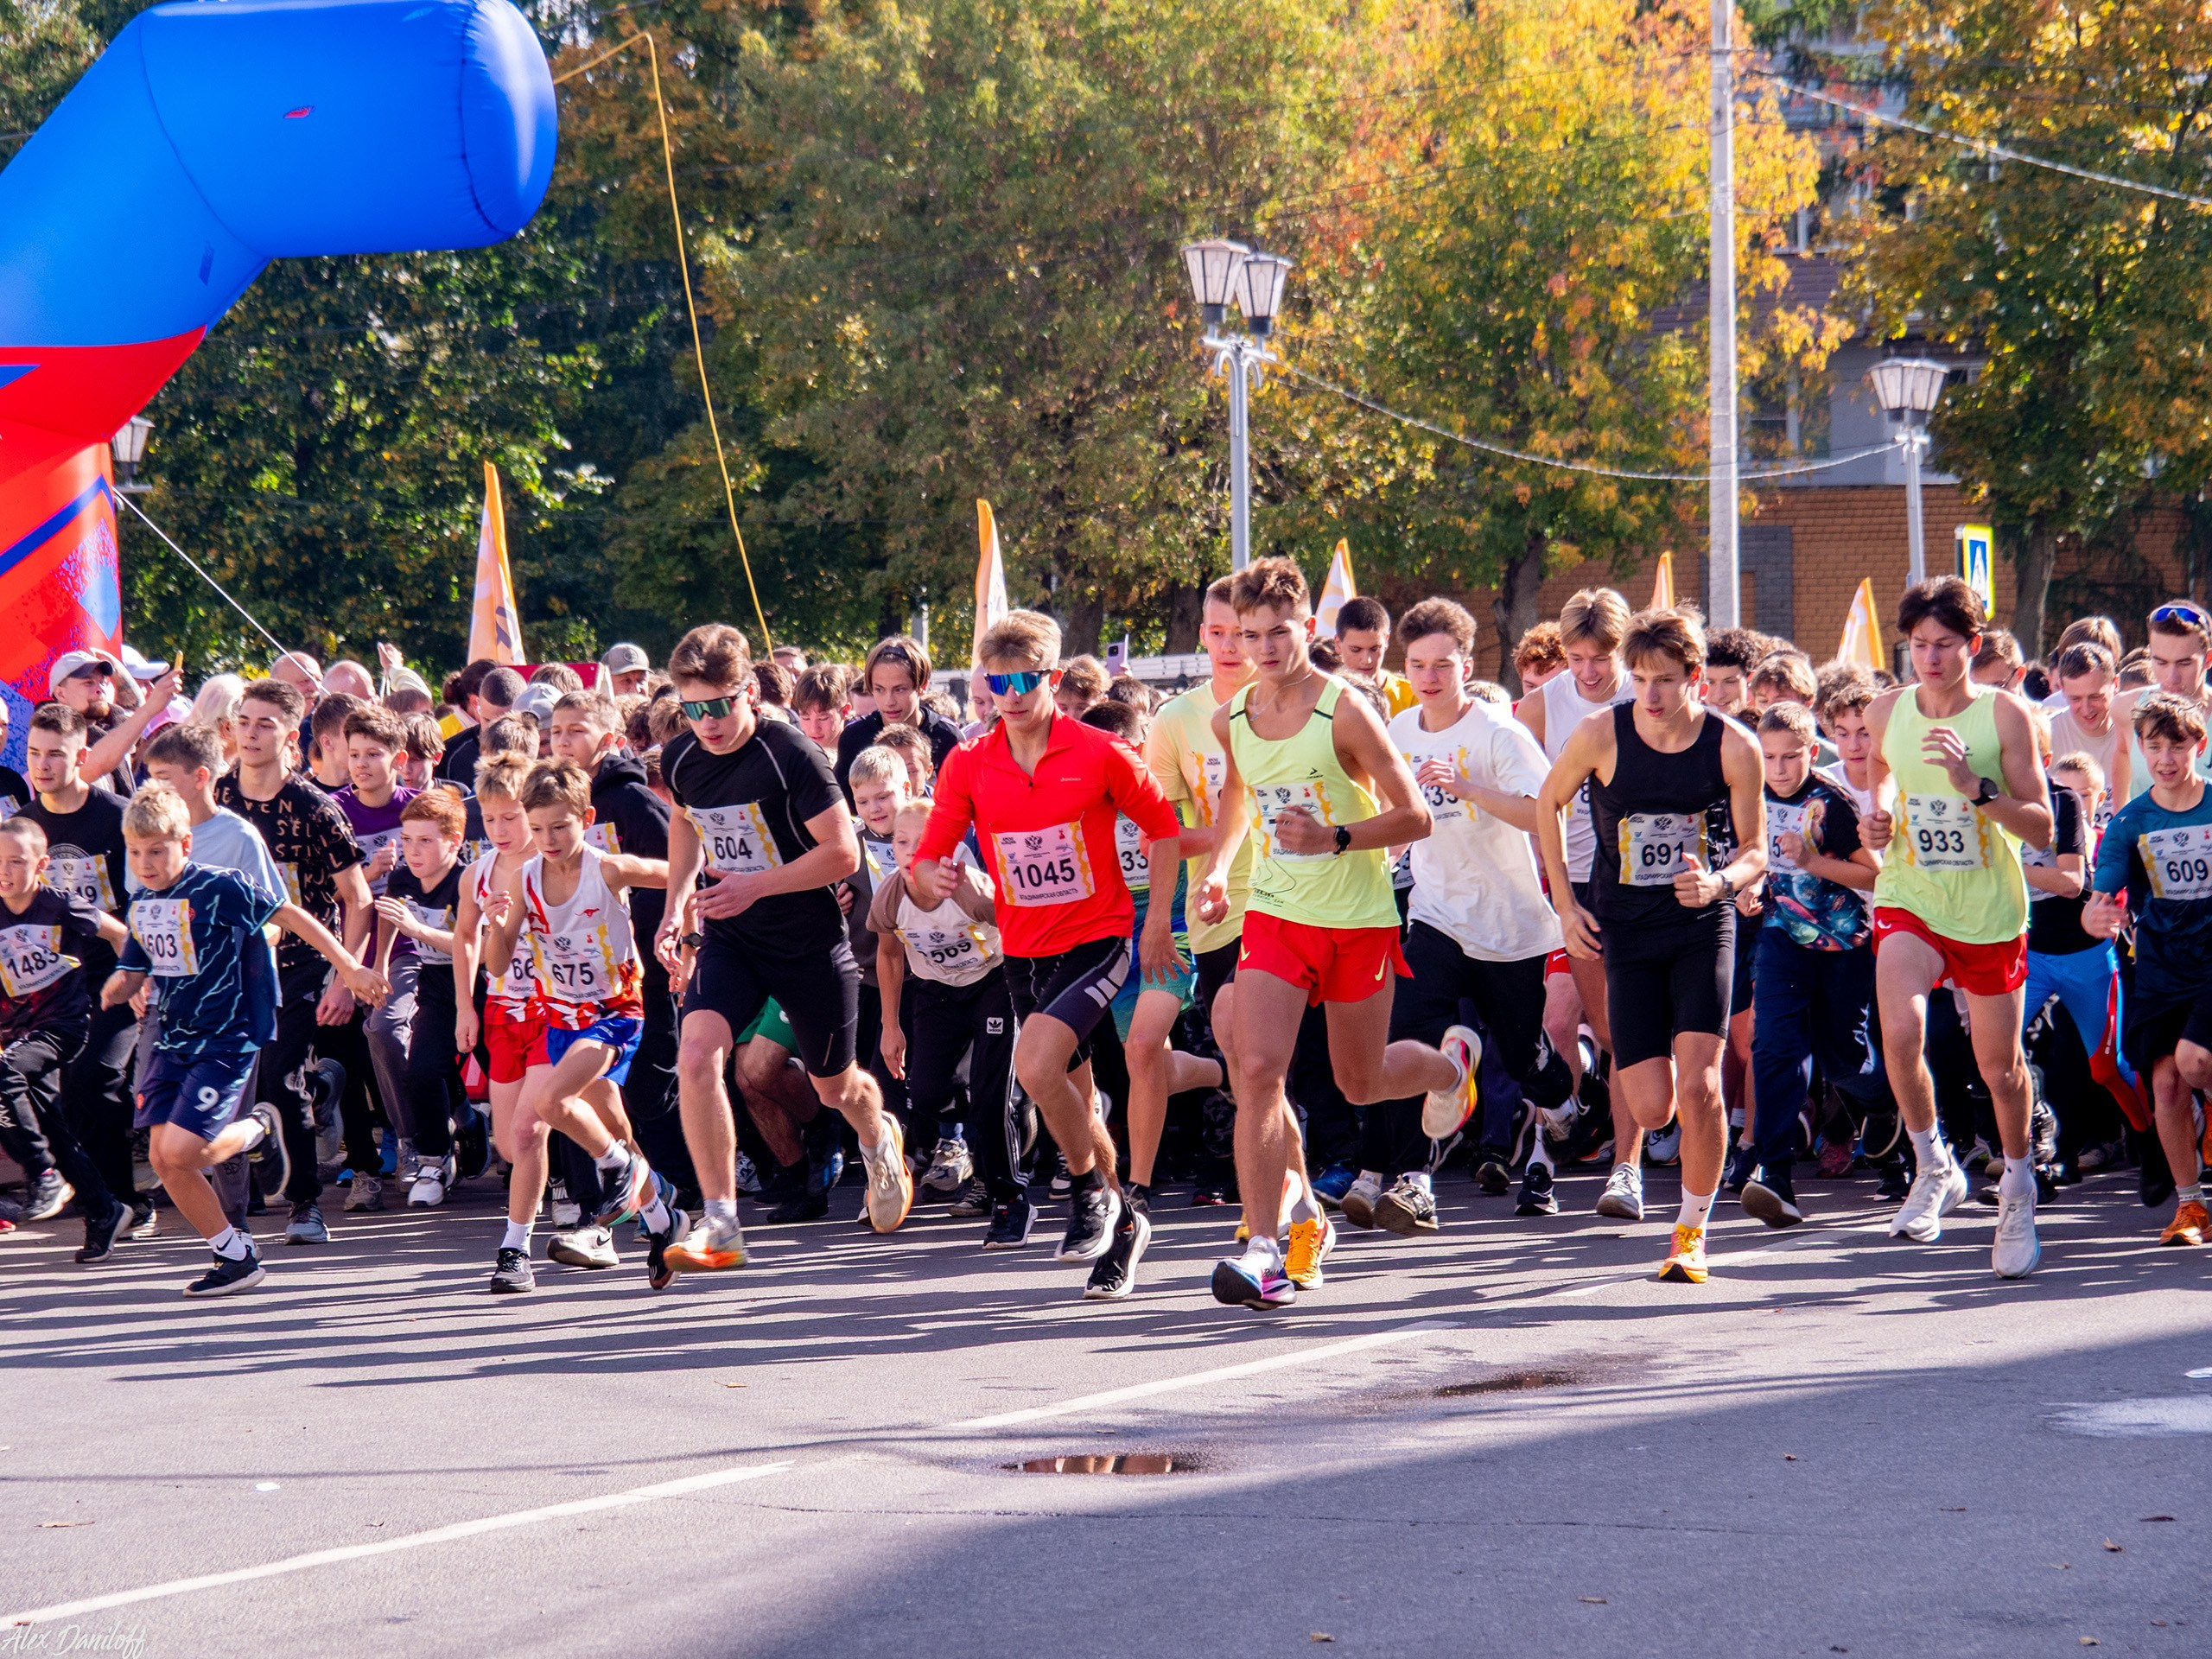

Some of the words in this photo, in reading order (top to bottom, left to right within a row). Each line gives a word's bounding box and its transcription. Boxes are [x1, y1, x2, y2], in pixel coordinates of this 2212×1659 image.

[714, 836, 753, 860] 604
[1918, 829, 1965, 853] 933
[1642, 842, 1684, 867] 691
[1013, 858, 1075, 888] 1045
[2166, 859, 2209, 882] 609
[7, 948, 60, 979] 1483
[512, 958, 535, 980] 66
[552, 963, 594, 986] 675
[194, 1086, 219, 1112] 9
[417, 1166, 444, 1180] NIKE
